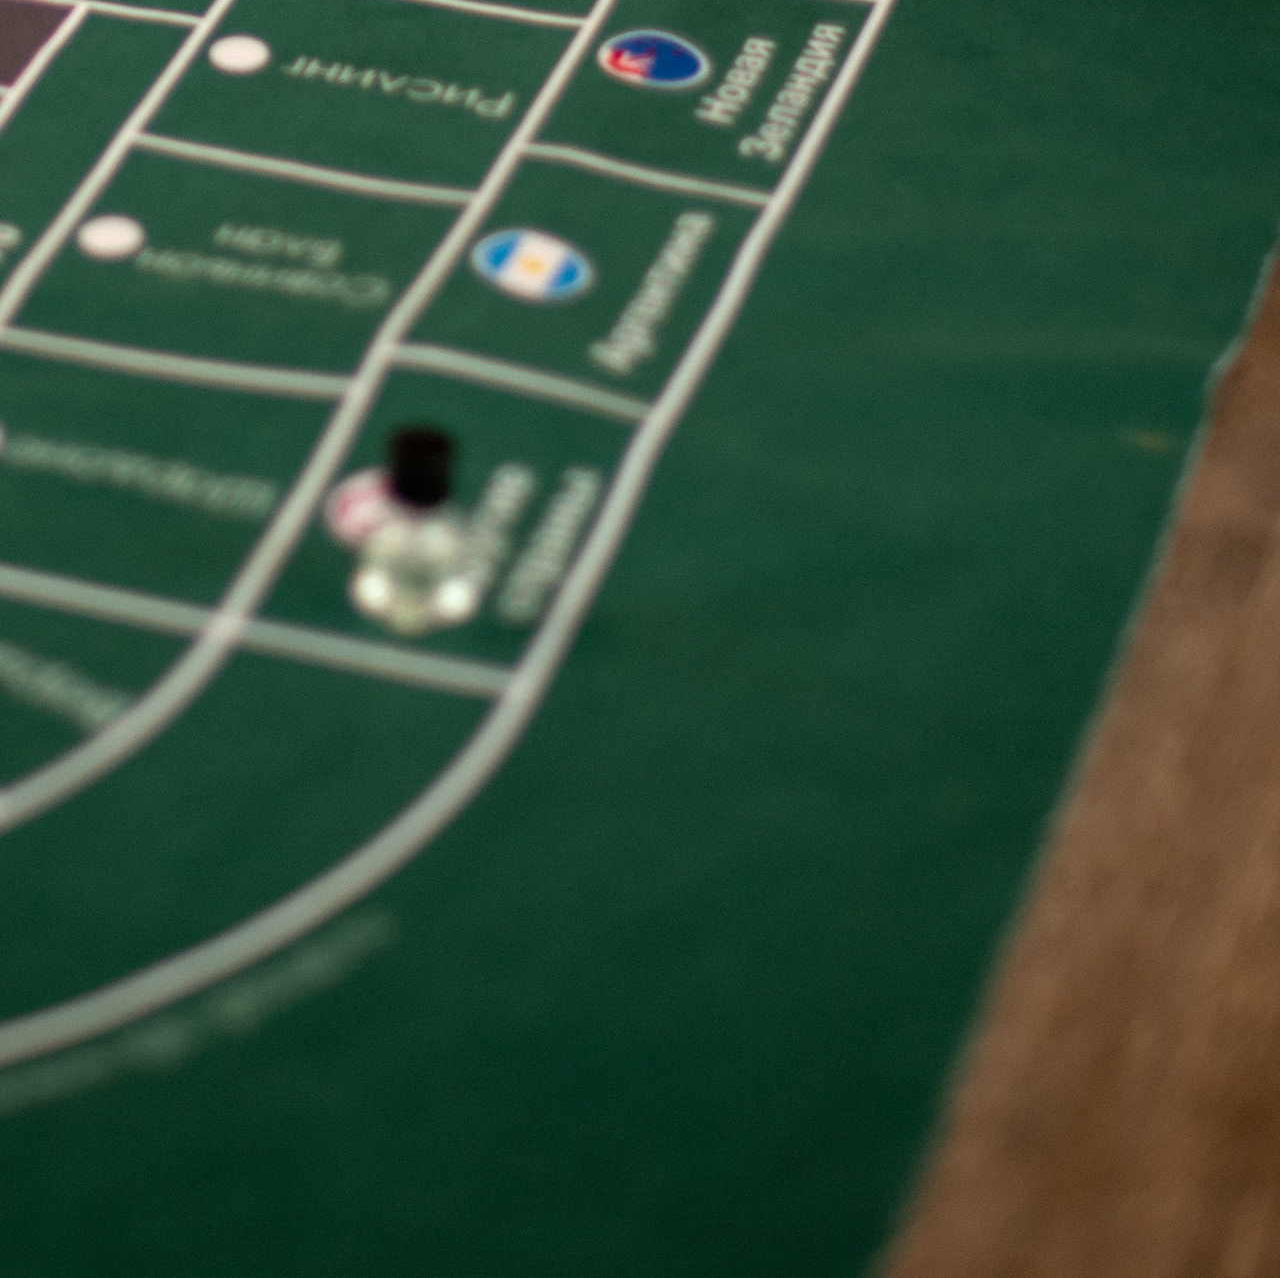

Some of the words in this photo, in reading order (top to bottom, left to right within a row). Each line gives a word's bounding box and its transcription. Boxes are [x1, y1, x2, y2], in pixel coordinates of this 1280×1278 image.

[281, 54, 517, 120] Рислинг
[694, 35, 776, 128] Новая
[736, 21, 846, 164] Зеландия
